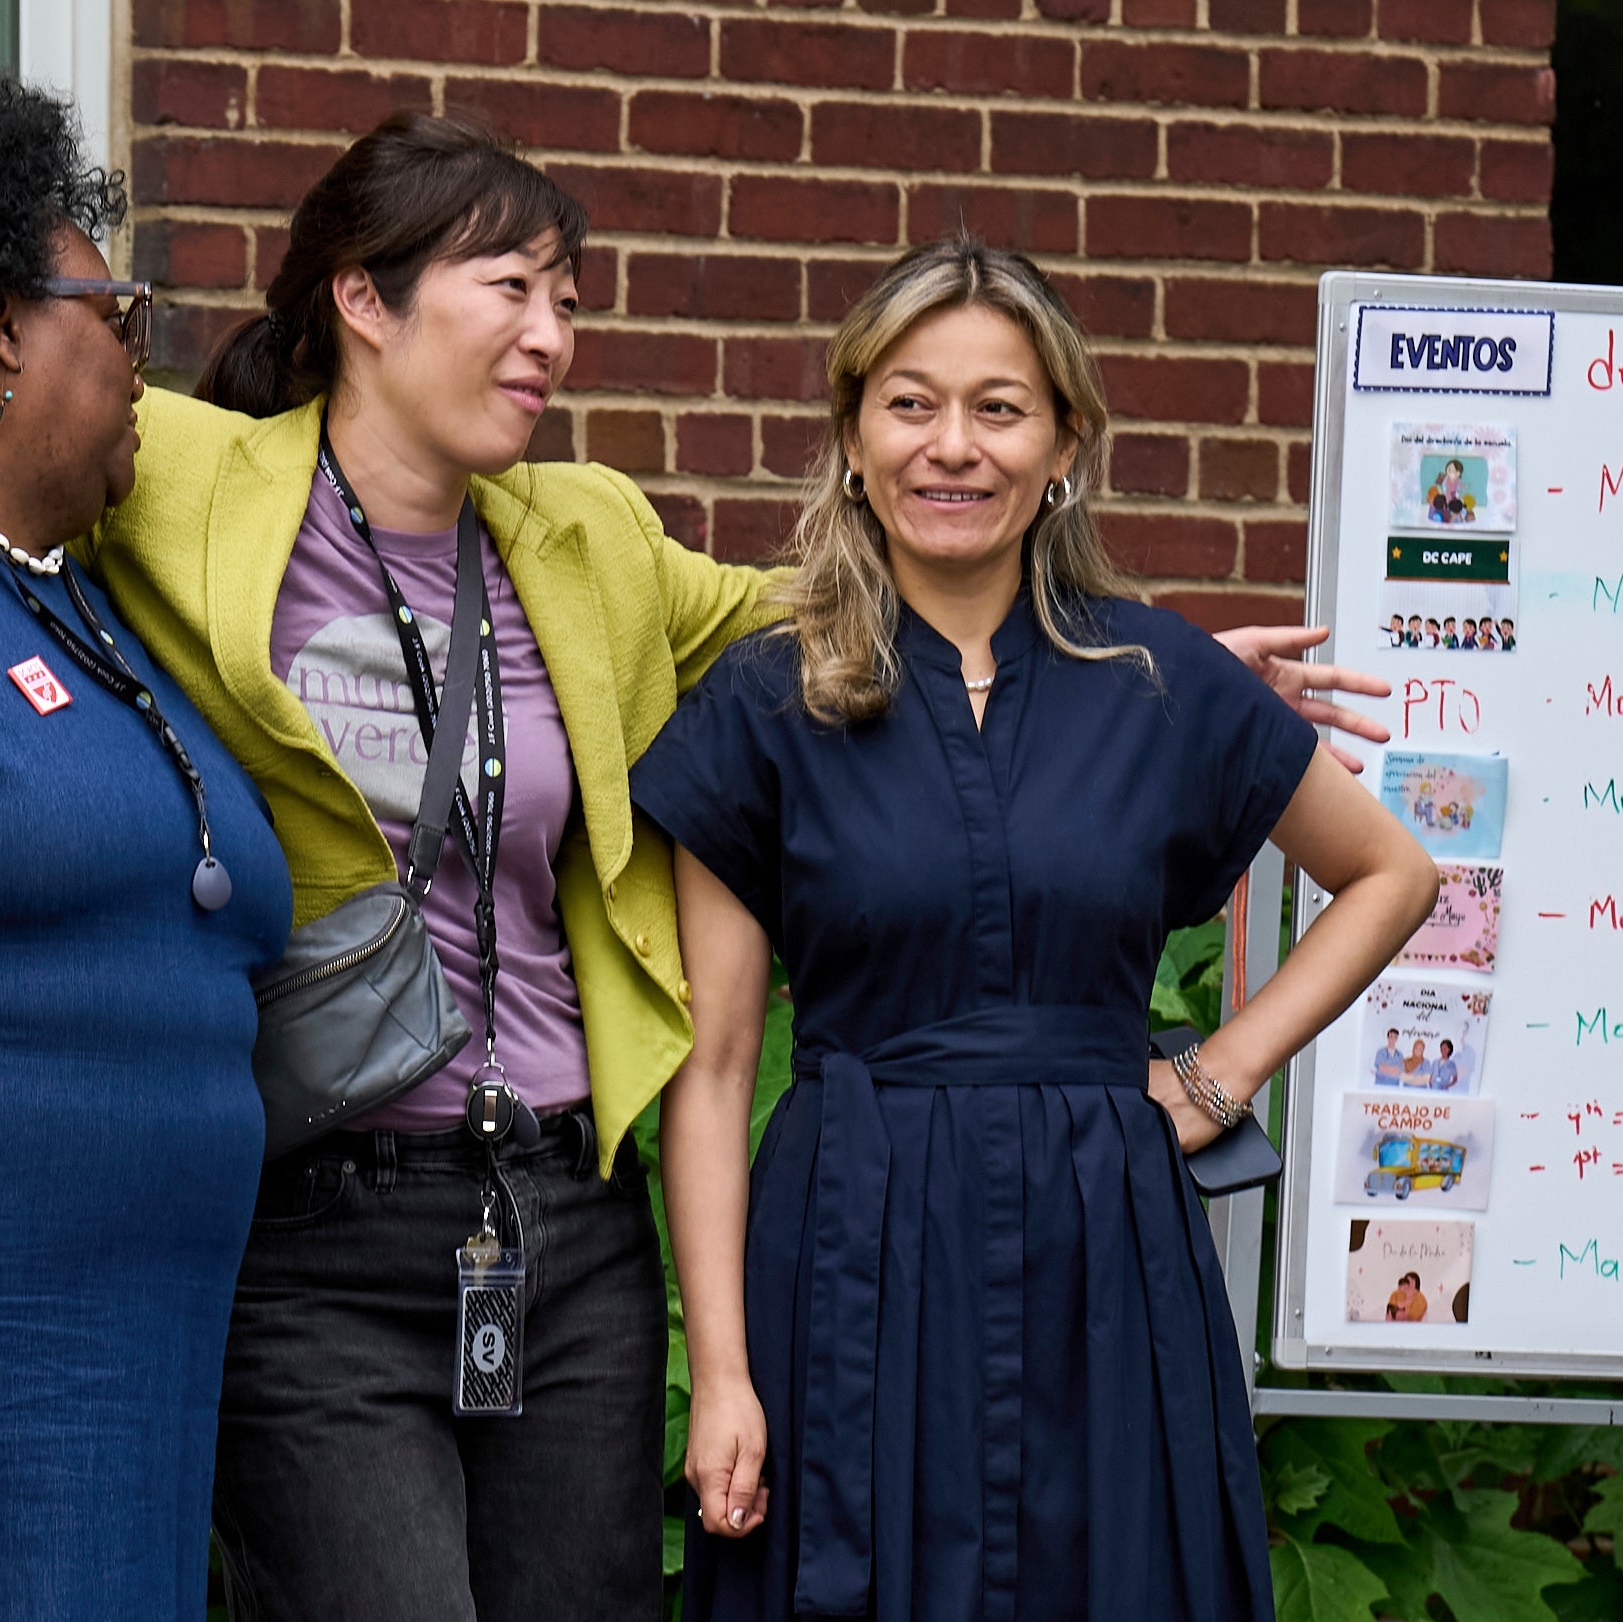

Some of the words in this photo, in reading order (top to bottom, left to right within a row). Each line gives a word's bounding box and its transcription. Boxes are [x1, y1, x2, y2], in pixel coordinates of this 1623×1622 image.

[1390, 332, 1517, 372] EVENTOS
[1422, 551, 1439, 564] DC
[1440, 551, 1473, 566] CAPE
[300, 666, 418, 712] mun
[1363, 1103, 1430, 1117] TRABAJO
[1433, 1106, 1451, 1119] DE
[1378, 1116, 1433, 1131] CAMPO
[482, 1331, 496, 1366] SV
